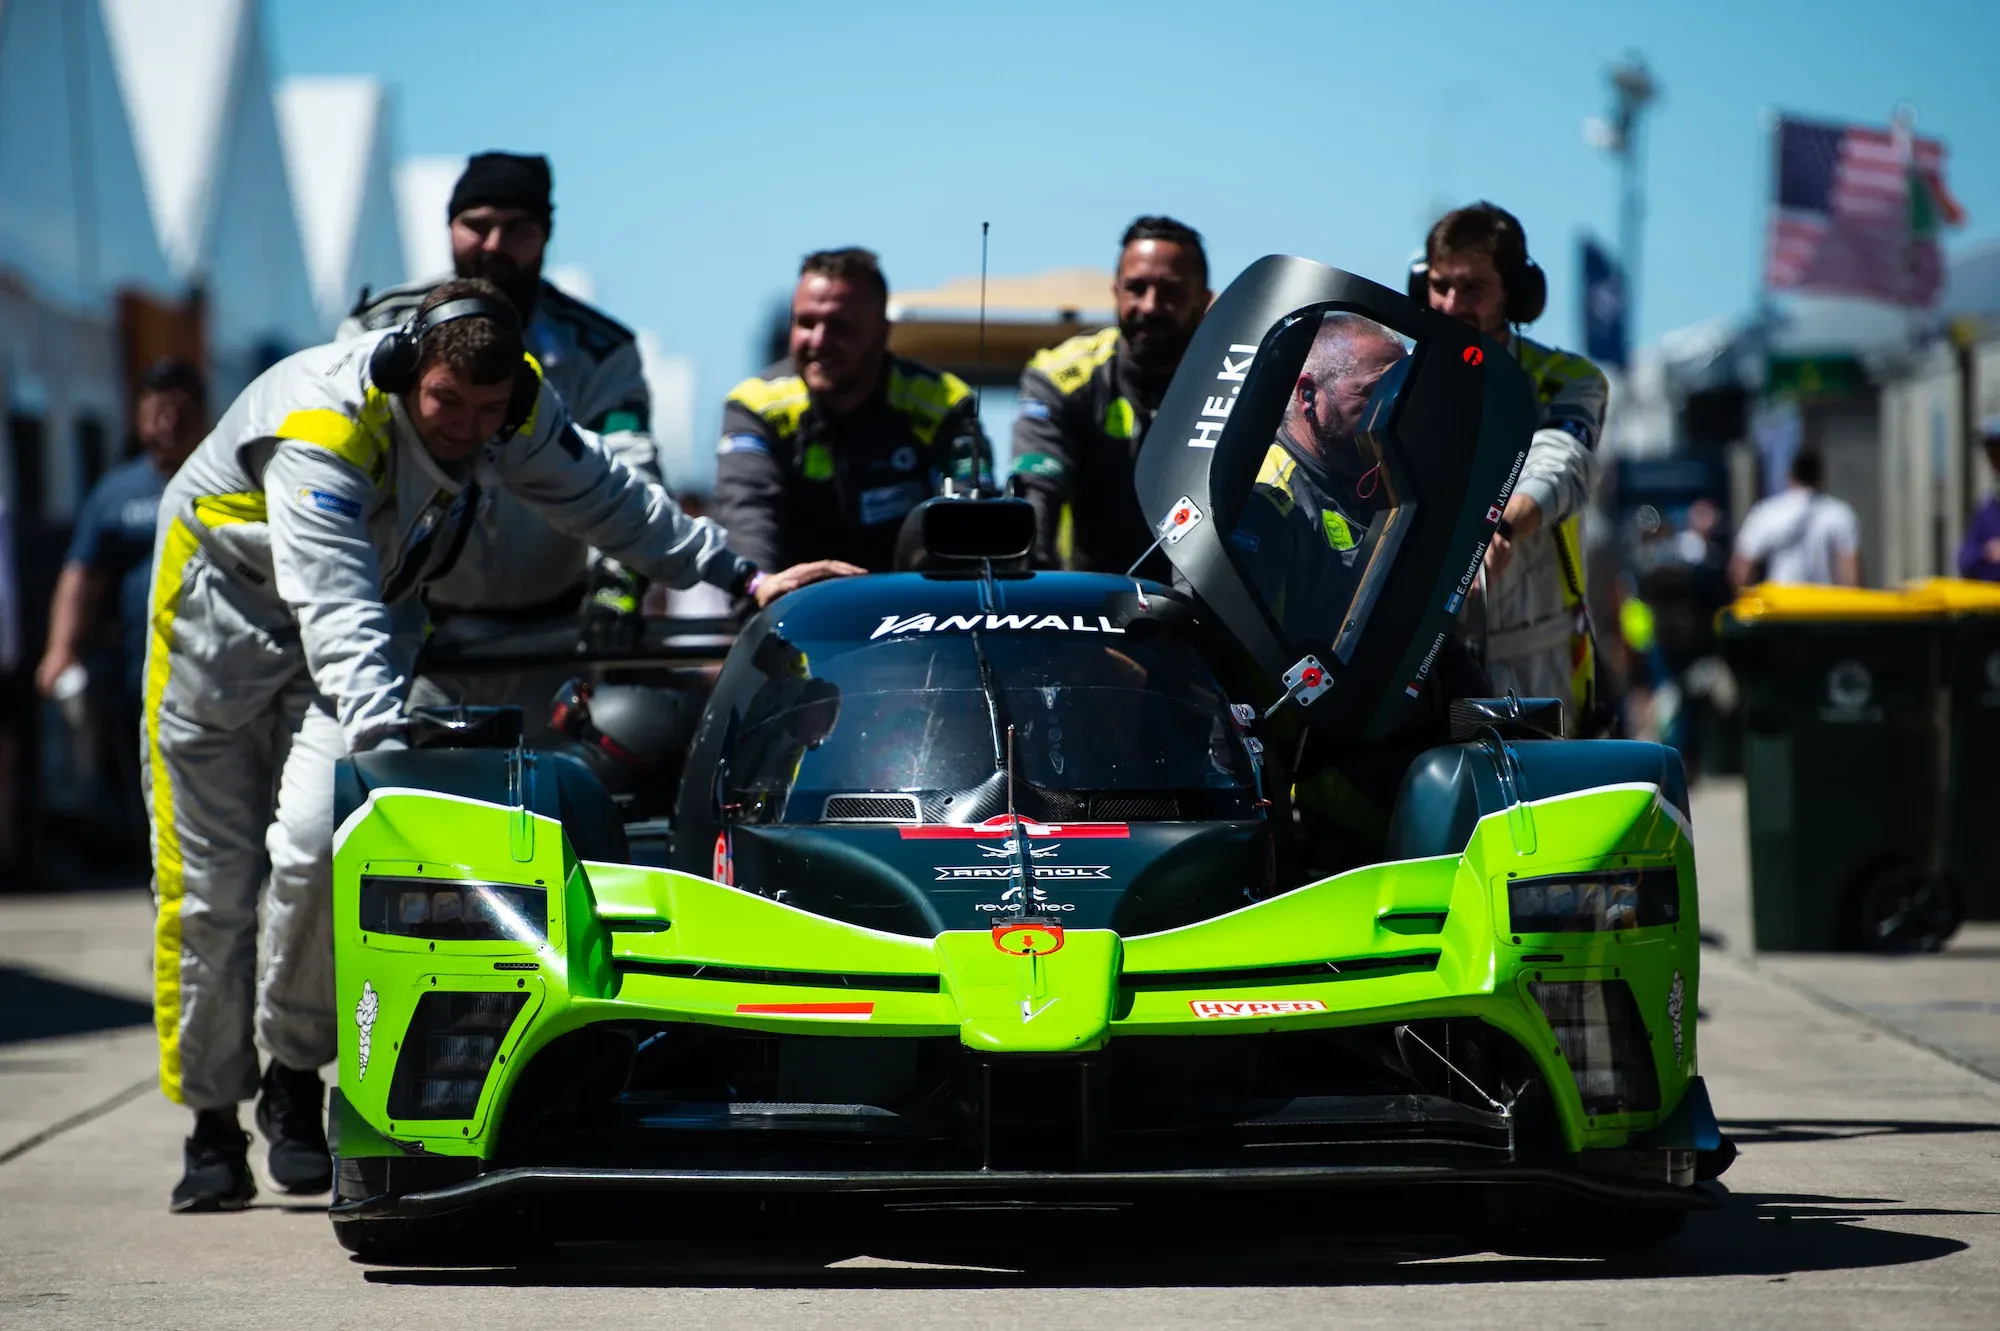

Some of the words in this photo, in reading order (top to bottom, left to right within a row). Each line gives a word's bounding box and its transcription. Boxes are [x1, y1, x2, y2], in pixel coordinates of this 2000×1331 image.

[1187, 343, 1259, 448] HE.KI
[1497, 450, 1526, 507] J.Villeneuve
[1456, 541, 1486, 595] E.Guerrieri
[870, 613, 1126, 640] VANWALL
[1415, 632, 1446, 681] T.Dillmann
[1200, 1003, 1316, 1012] HYPER
